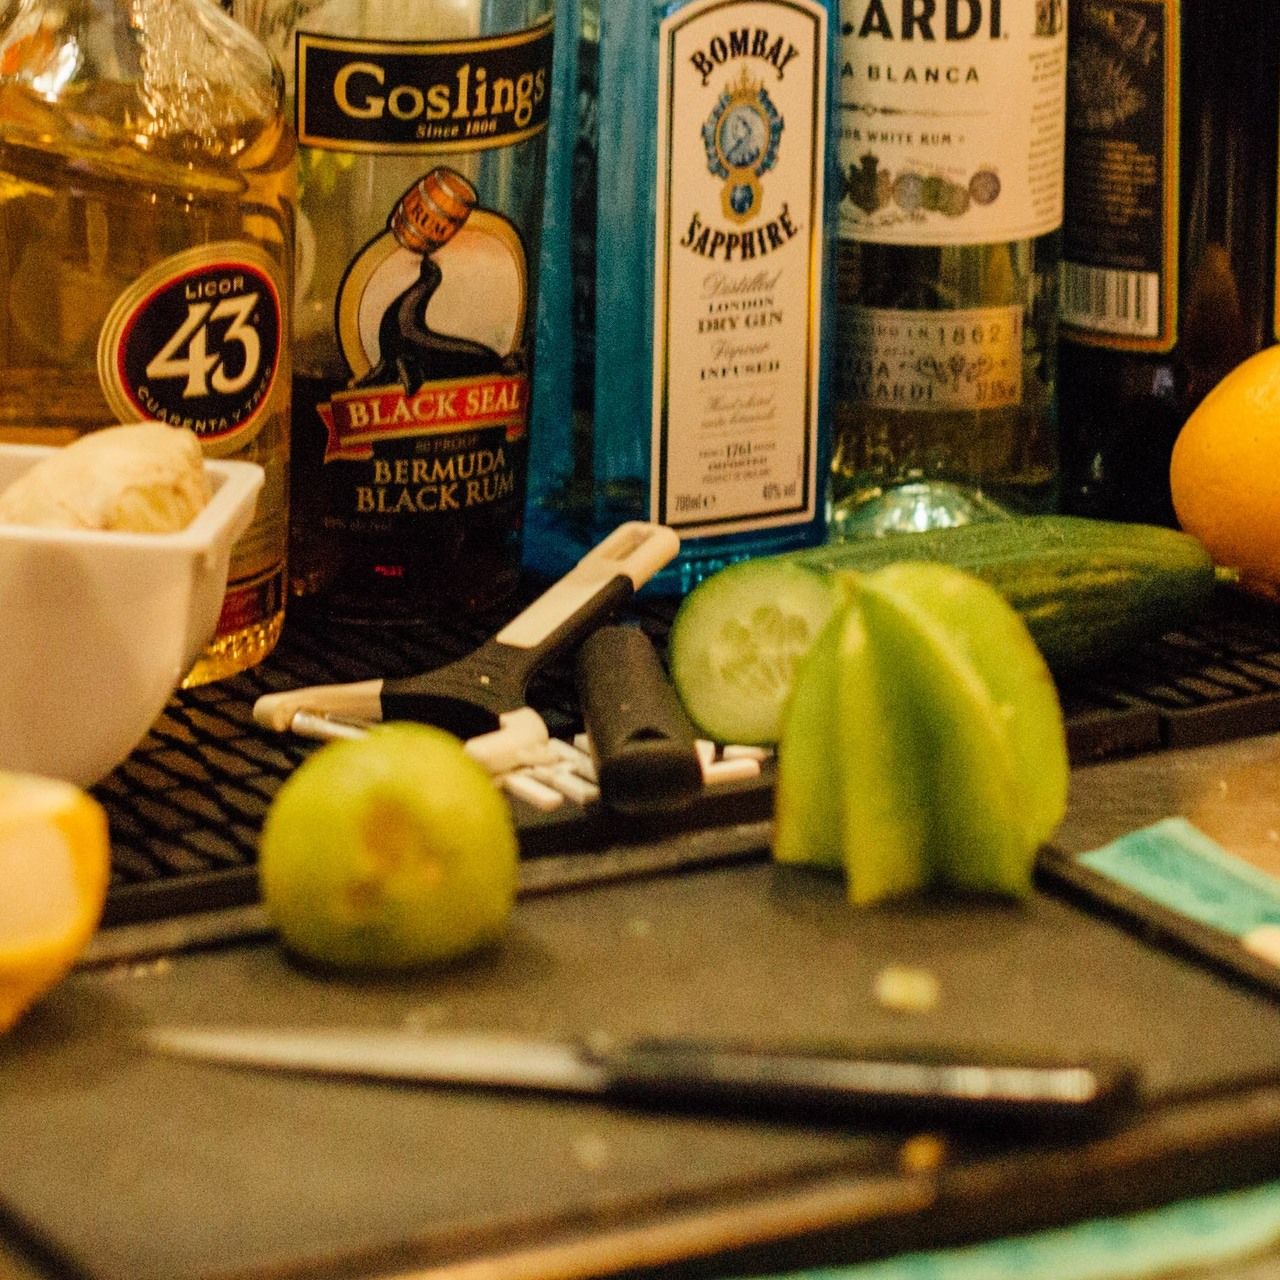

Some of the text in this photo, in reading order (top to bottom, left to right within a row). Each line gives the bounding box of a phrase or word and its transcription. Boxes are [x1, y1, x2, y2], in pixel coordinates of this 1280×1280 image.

[690, 27, 800, 87] BOMBAY
[868, 64, 980, 84] BLANCA
[333, 61, 546, 129] Goslings
[416, 121, 459, 138] Since
[866, 129, 914, 145] WHITE
[920, 132, 952, 146] RUM
[680, 202, 799, 261] SAPPHIRE
[185, 276, 245, 300] LICOR
[708, 297, 775, 313] LONDON
[698, 311, 783, 334] DRY GIN
[145, 292, 261, 400] 43
[348, 383, 521, 428] BLACK SEAL
[373, 448, 506, 485] BERMUDA
[356, 469, 514, 513] BLACK RUM
